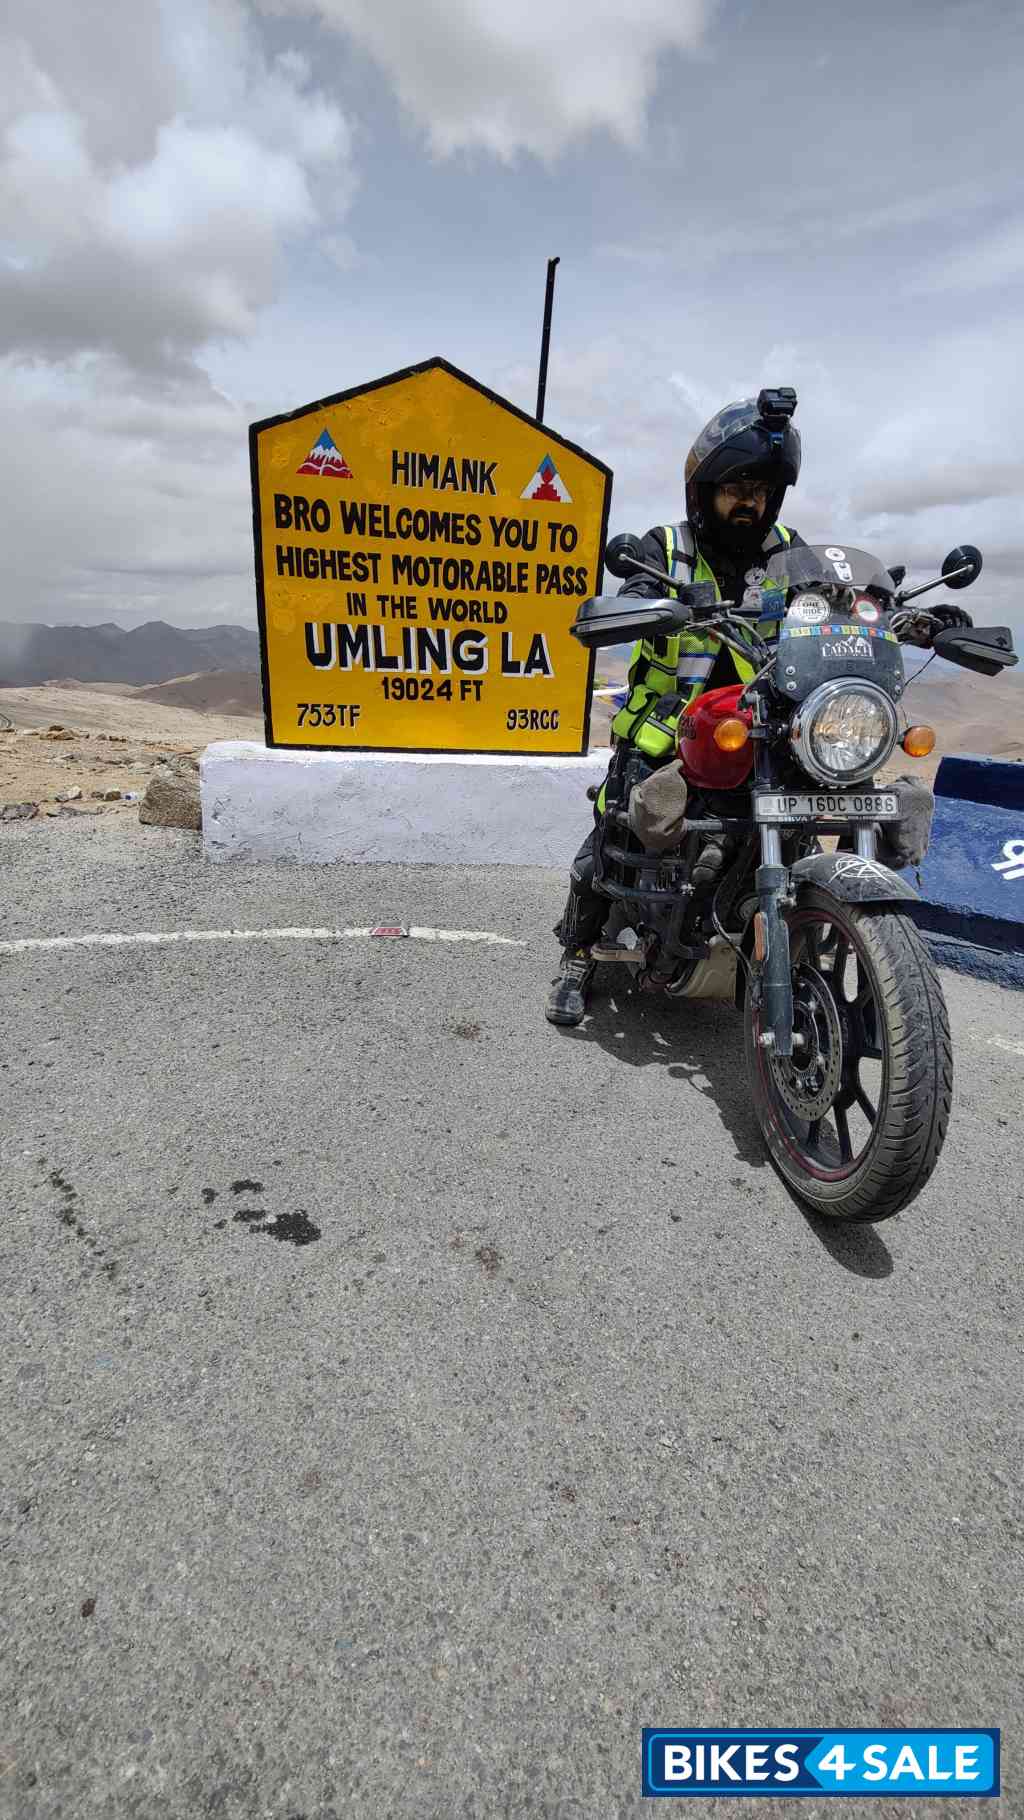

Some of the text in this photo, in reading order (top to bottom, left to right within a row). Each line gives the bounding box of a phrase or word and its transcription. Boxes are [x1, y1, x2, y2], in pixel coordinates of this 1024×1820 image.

[391, 449, 498, 495] HIMANK
[273, 493, 578, 553] BRO WELCOMES YOU TO
[275, 544, 588, 597] HIGHEST MOTORABLE PASS
[346, 591, 508, 625] IN THE WORLD
[304, 622, 554, 678] UMLING LA
[381, 677, 484, 702] 19024 FT
[296, 703, 361, 728] 753TF
[506, 709, 560, 731] 93RCC
[777, 797, 798, 814] UP
[807, 796, 847, 813] 16DC
